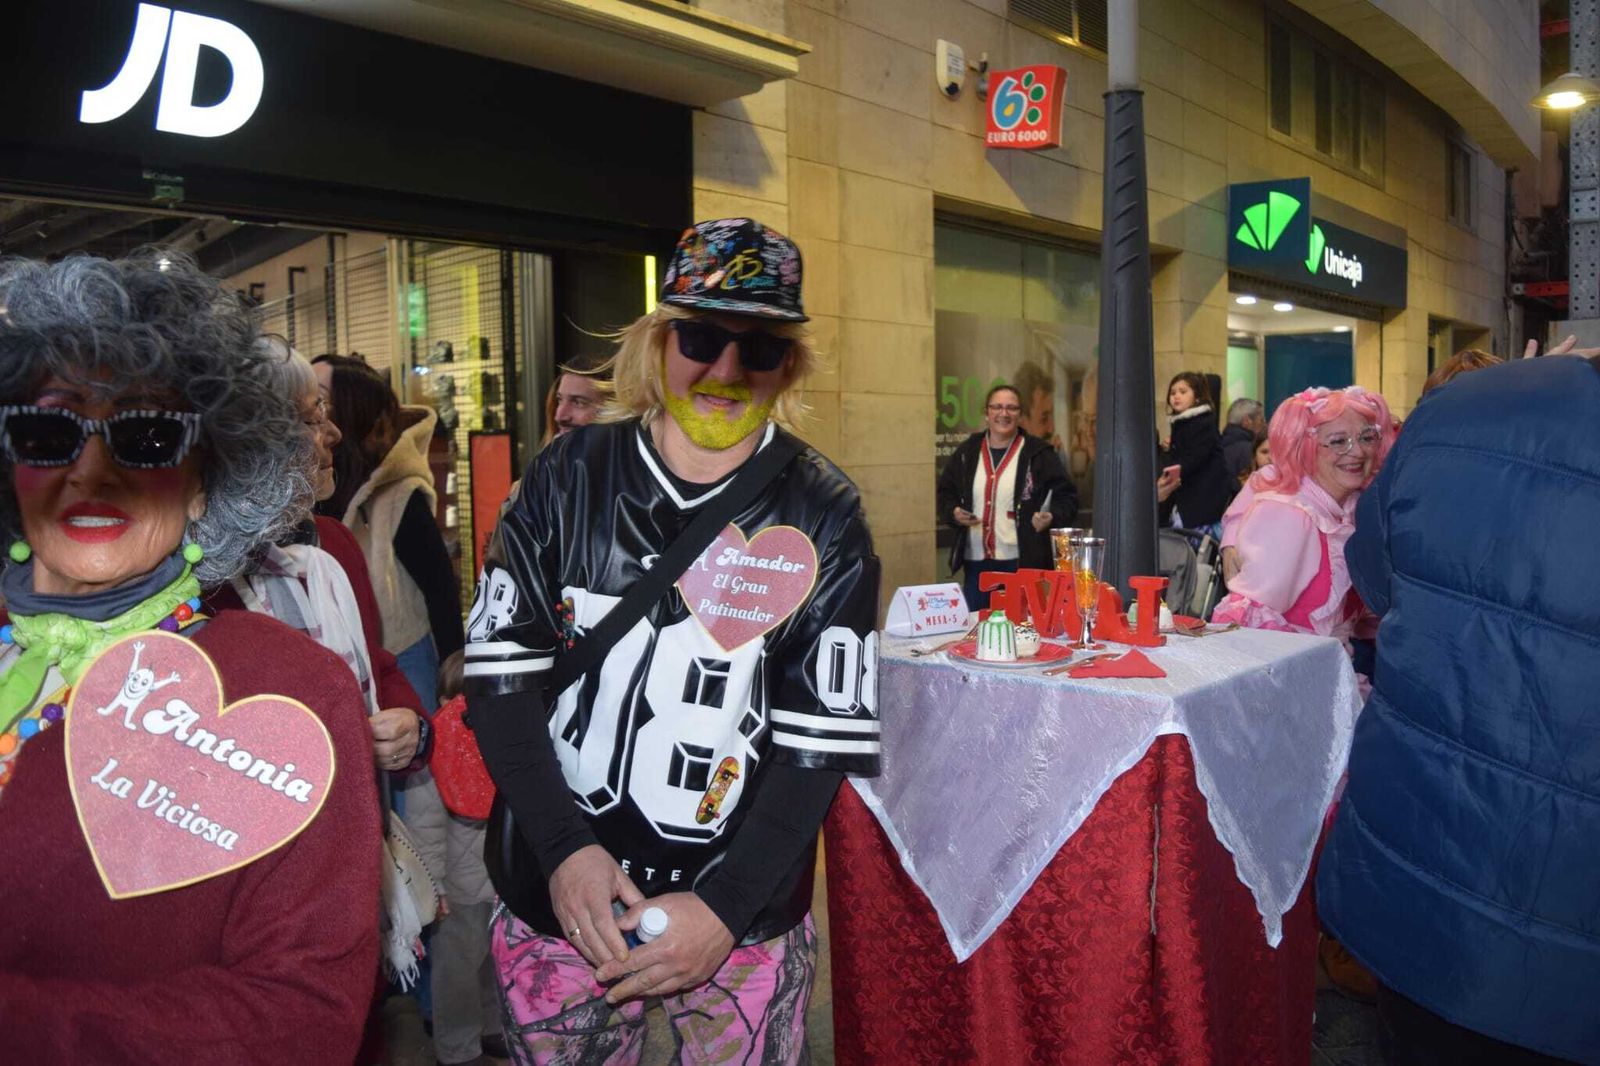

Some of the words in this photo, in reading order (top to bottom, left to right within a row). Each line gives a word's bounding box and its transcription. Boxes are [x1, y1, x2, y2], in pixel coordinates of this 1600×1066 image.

[79, 2, 264, 137] JD
[987, 131, 1015, 143] EURO
[1017, 130, 1047, 142] 6000
[1325, 246, 1362, 288] Unicaja
[716, 547, 805, 573] Amador
[712, 573, 729, 589] El
[731, 576, 768, 594] Gran
[698, 599, 775, 623] Patinador
[142, 698, 313, 803] Antonia
[91, 758, 134, 799] La
[136, 779, 239, 851] Viciosa
